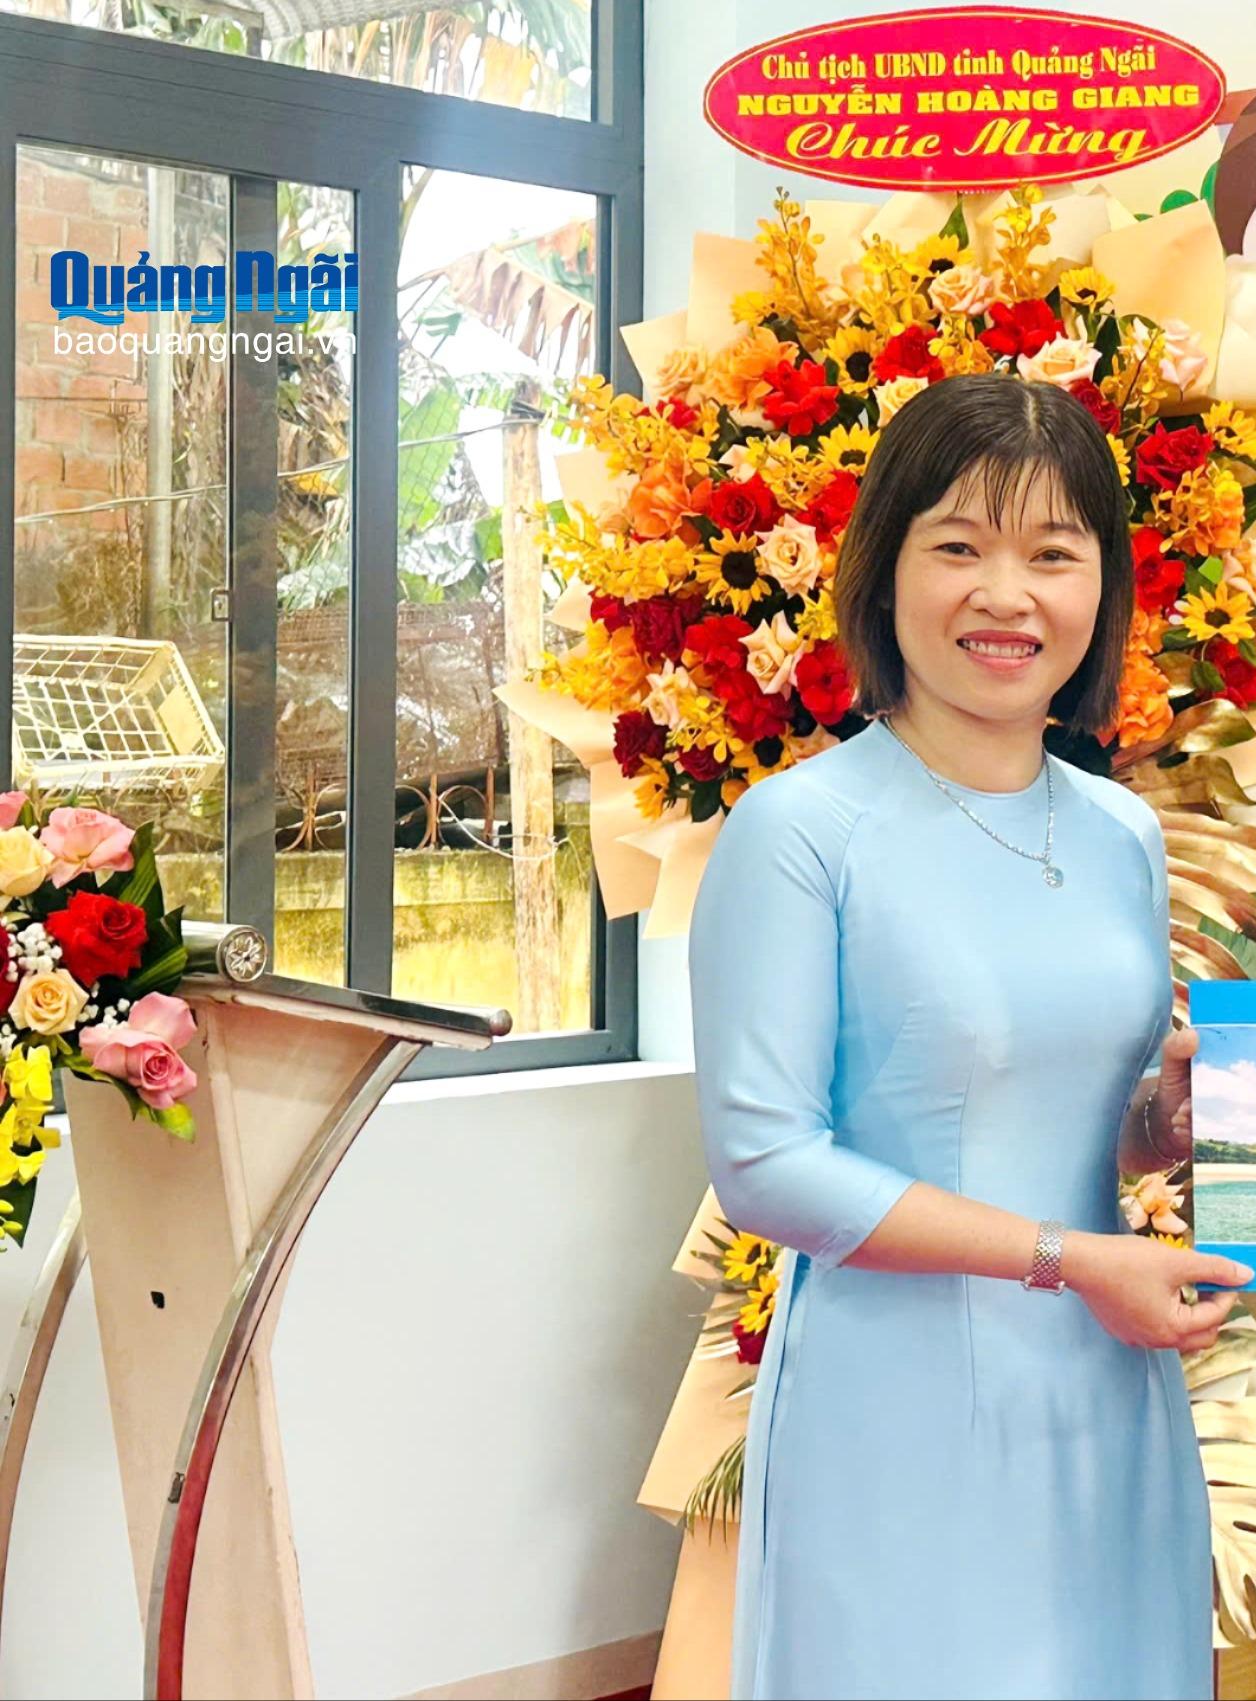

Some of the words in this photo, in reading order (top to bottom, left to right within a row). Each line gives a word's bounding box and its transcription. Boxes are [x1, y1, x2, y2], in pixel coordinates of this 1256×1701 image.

[761, 51, 811, 80] Chủ
[818, 53, 867, 85] tịch
[874, 51, 947, 78] UBND
[1011, 46, 1094, 82] Quảng
[1100, 44, 1156, 77] Ngãi
[738, 83, 902, 116] NGUYỄN
[917, 84, 1058, 113] HOÀNG
[1072, 84, 1200, 110] GIANG
[786, 121, 942, 160] Chúc
[953, 117, 1151, 163] Mừng
